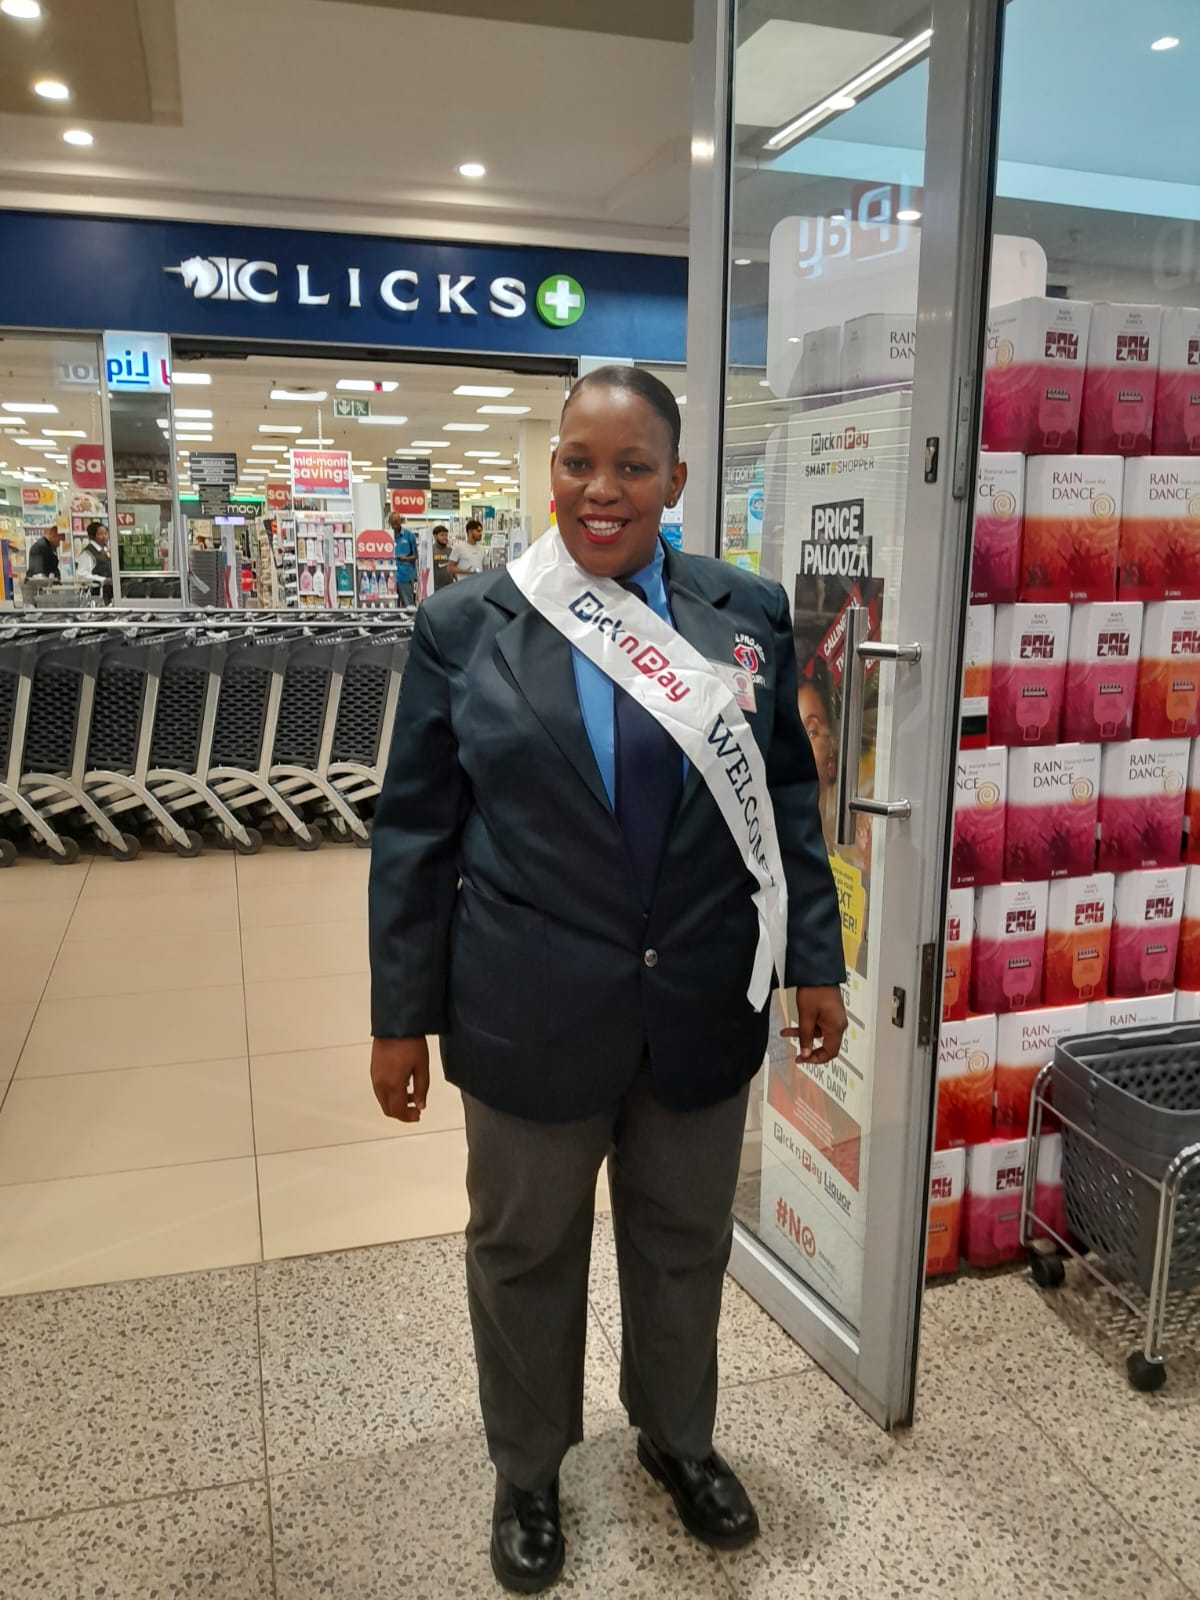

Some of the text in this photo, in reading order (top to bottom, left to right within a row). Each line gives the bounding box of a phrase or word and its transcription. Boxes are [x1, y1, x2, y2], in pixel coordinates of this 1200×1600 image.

[237, 260, 527, 318] CLICKS
[890, 347, 916, 359] DAN
[75, 458, 105, 472] sa
[805, 457, 874, 477] SMART SHOPPER
[294, 468, 350, 482] savings
[1052, 471, 1083, 485] RAIN
[1149, 473, 1179, 486] RAIN
[268, 489, 293, 500] sav
[394, 495, 424, 505] save
[1052, 487, 1095, 500] DANCE
[1149, 488, 1191, 501] DANCE
[815, 505, 861, 539] PRICE
[358, 541, 394, 553] save
[804, 543, 868, 577] PALOOZA
[1129, 752, 1156, 766] RAIN
[1033, 760, 1062, 774] RAIN
[1129, 766, 1167, 780] DANCE
[957, 777, 980, 790] NCE
[1033, 773, 1075, 787] DANCE
[1109, 1013, 1137, 1026] RAIN
[1022, 1024, 1050, 1038] RAIN
[939, 1036, 958, 1048] AIN
[1022, 1037, 1057, 1051] DANC
[939, 1047, 970, 1062] ANCE
[831, 1060, 848, 1086] WIN
[826, 1074, 847, 1104] DAILY
[824, 1171, 852, 1215] Liquor
